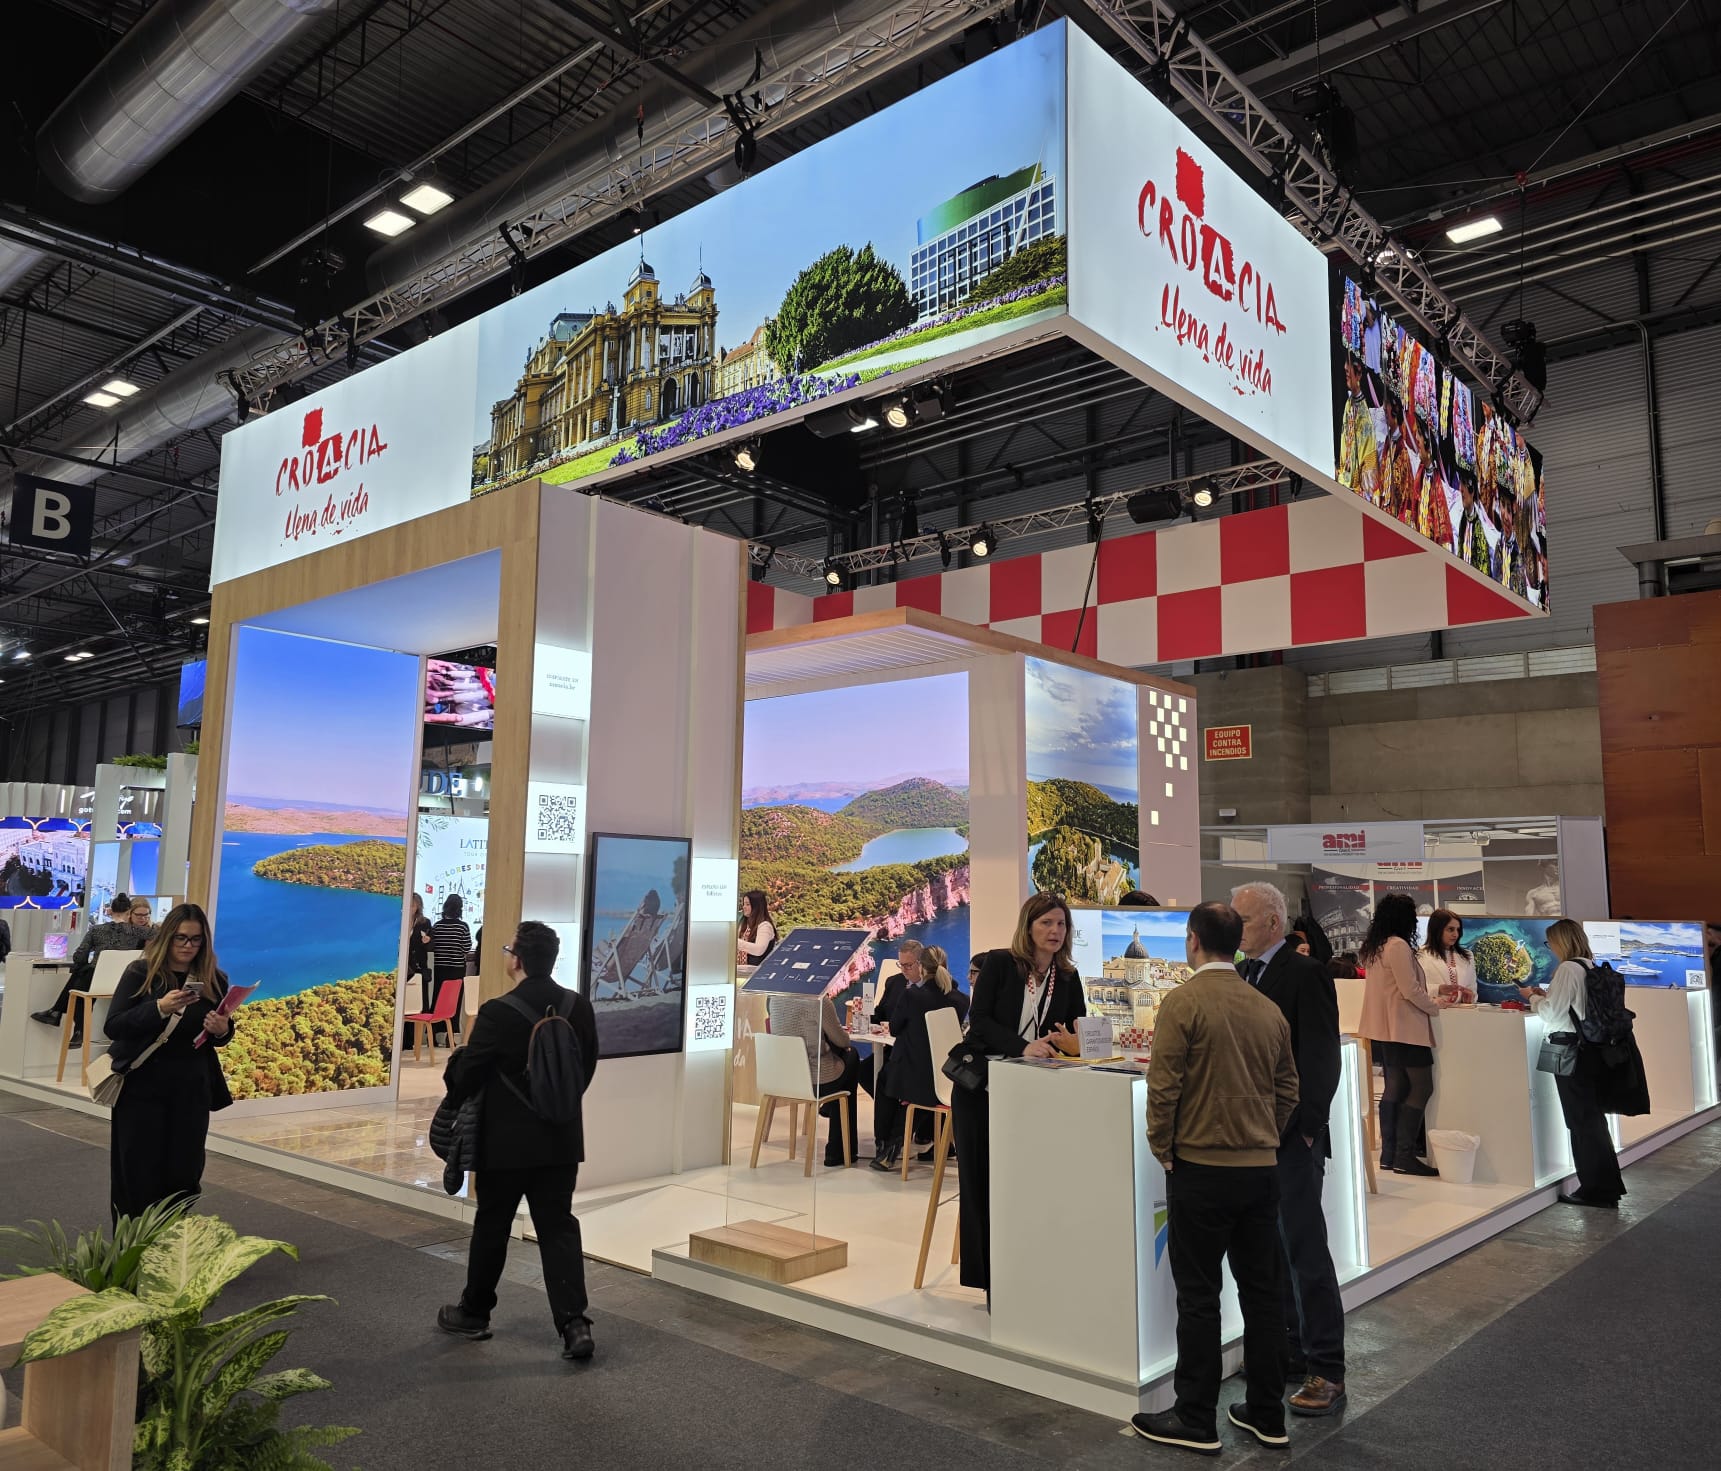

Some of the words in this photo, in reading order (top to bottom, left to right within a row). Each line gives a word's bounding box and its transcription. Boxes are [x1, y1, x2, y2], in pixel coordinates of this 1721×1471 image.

[1138, 180, 1287, 336] CROACIA
[1214, 322, 1234, 370] de
[1239, 349, 1272, 396] vida
[276, 423, 388, 497] CROACIA
[31, 488, 71, 540] B
[320, 493, 337, 528] de
[340, 483, 369, 522] vida
[1209, 747, 1247, 756] INCENDIOS
[1213, 739, 1242, 747] CONTRA
[1214, 730, 1241, 738] EQUIPO
[1322, 829, 1366, 849] ami
